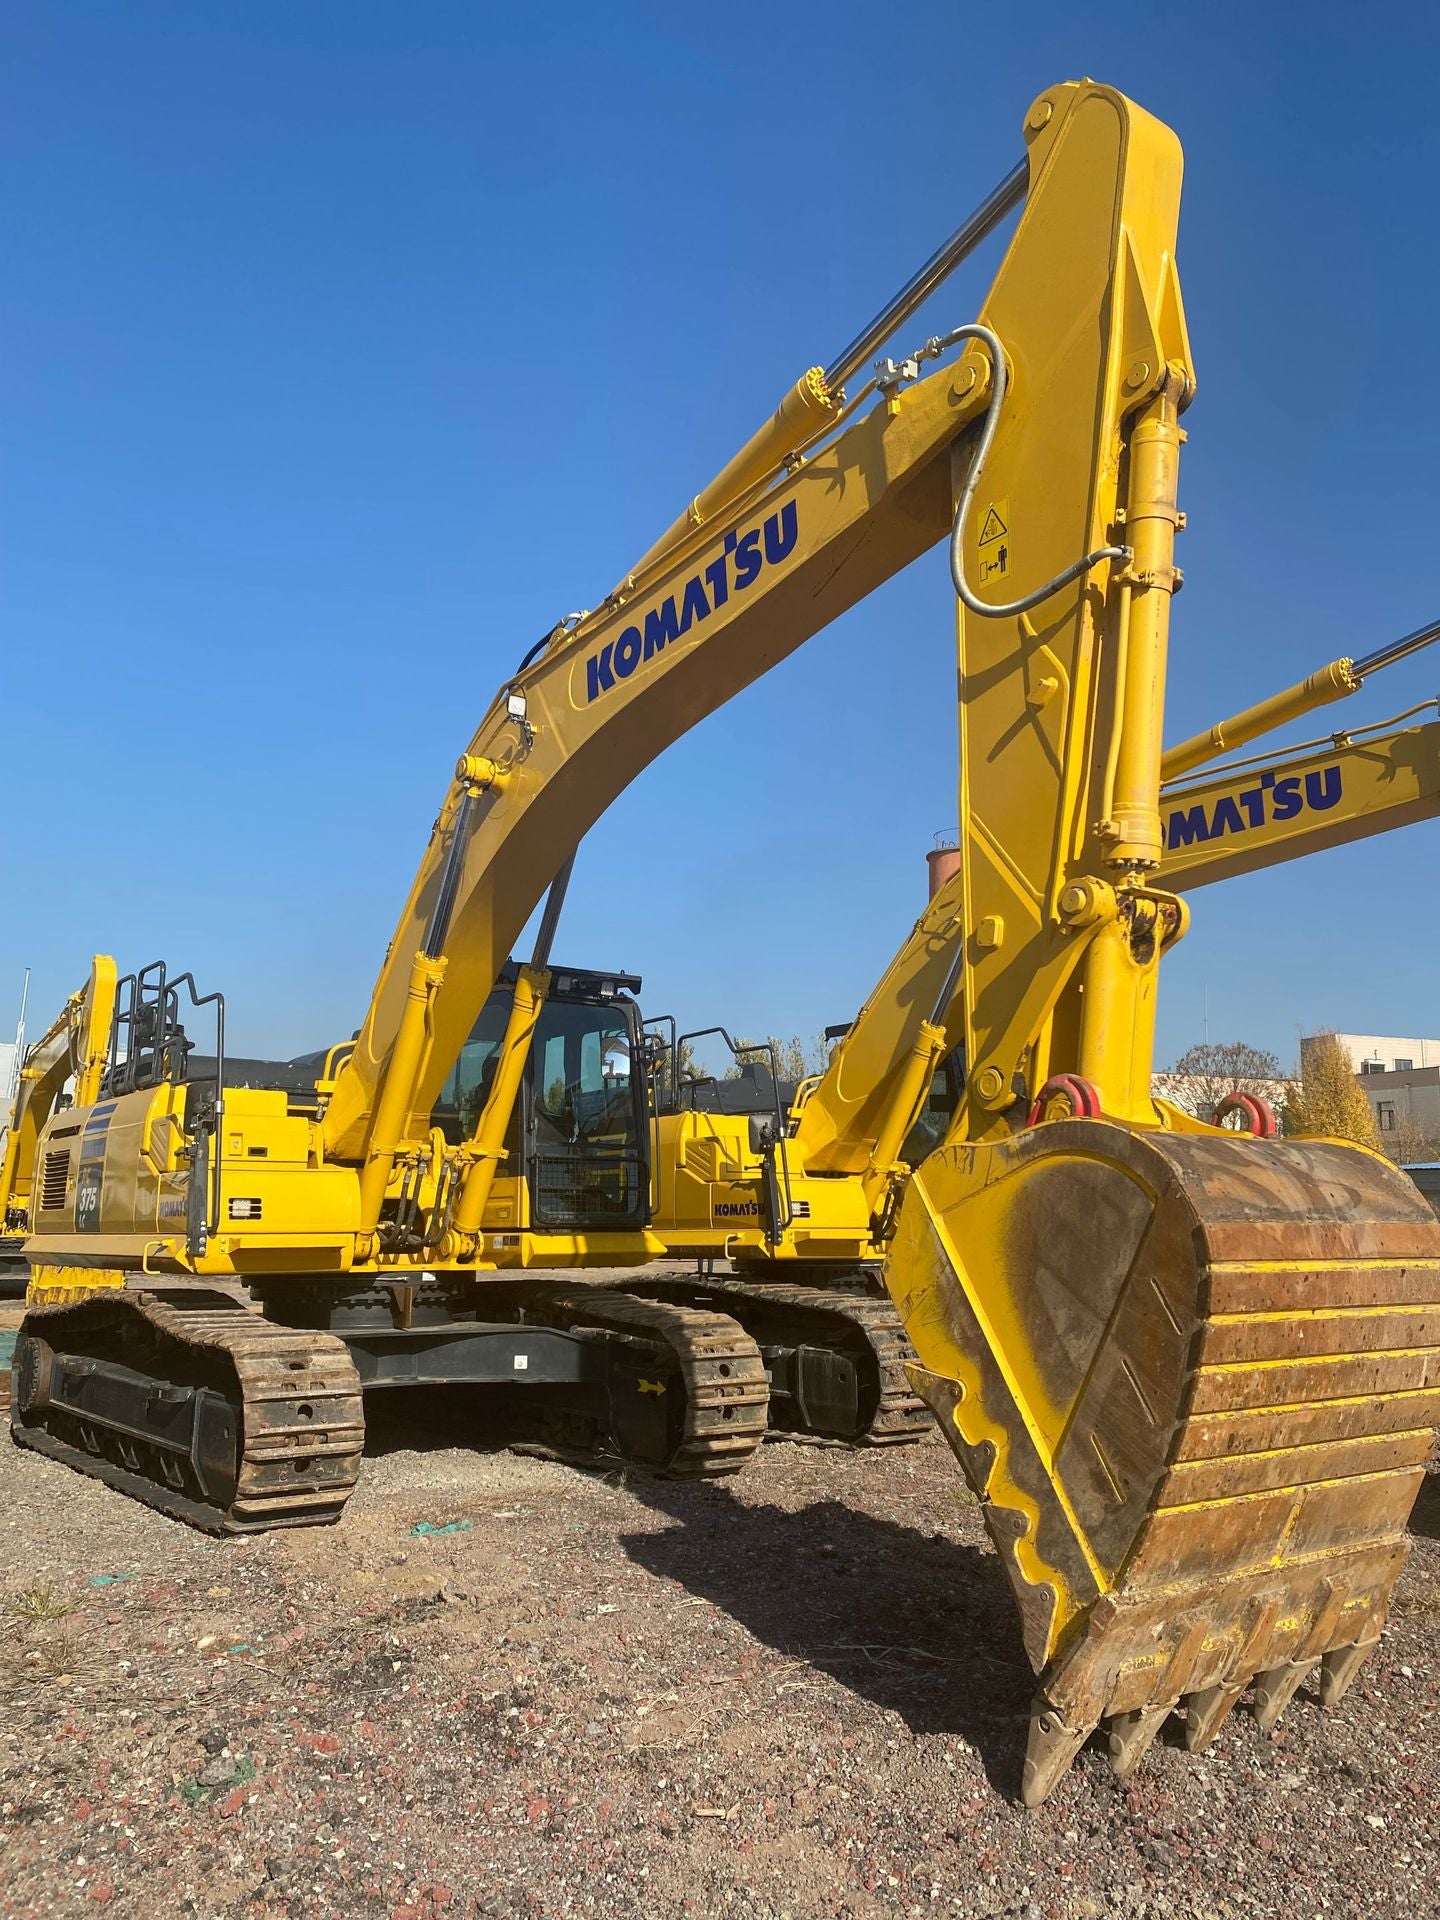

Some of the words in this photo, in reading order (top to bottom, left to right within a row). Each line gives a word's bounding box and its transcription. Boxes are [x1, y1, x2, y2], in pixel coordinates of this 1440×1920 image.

[585, 498, 799, 703] KOMATSU
[1160, 765, 1343, 850] MATSU
[79, 1187, 98, 1212] 375
[160, 1196, 189, 1217] KOMATS
